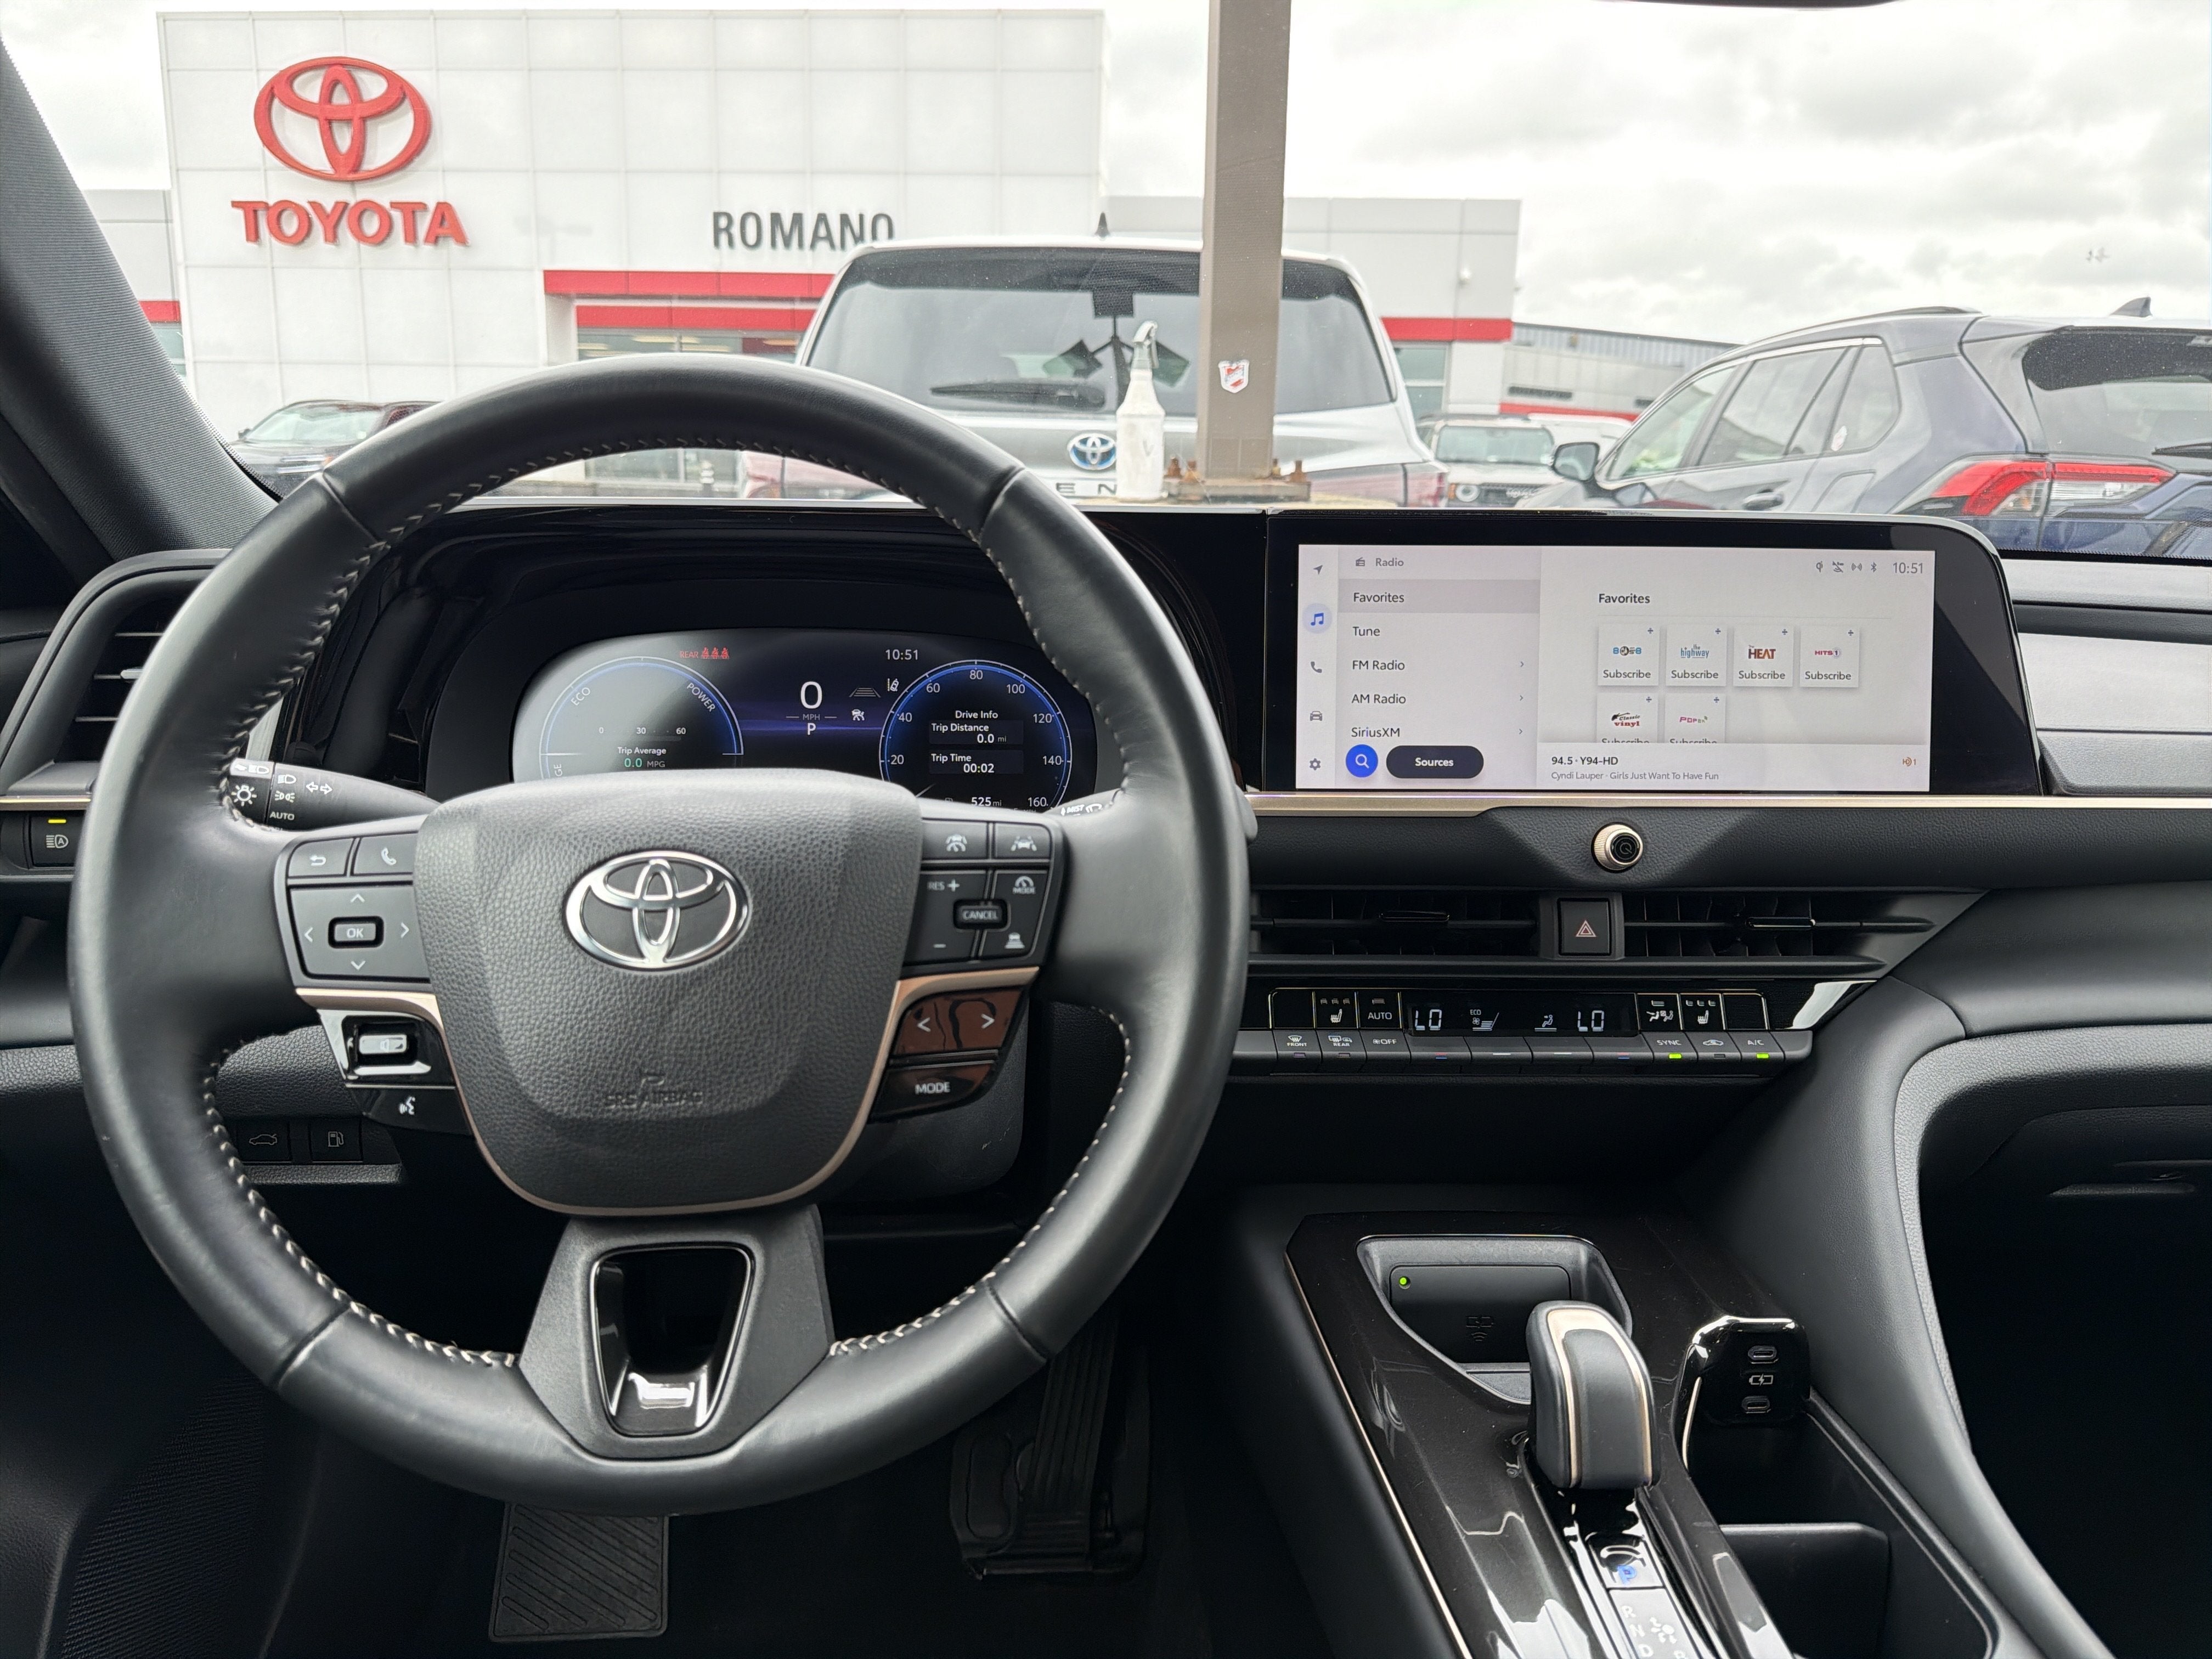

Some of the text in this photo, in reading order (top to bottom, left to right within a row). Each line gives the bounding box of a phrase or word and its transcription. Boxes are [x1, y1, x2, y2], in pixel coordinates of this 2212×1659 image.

[231, 199, 471, 246] TOYOTA
[712, 211, 894, 250] ROMANO
[1375, 557, 1404, 567] Radio
[1893, 562, 1924, 574] 10:51
[1353, 592, 1405, 603] Favorites
[1598, 593, 1651, 604] Favorites
[1352, 627, 1381, 637] Tune
[885, 649, 919, 661] 10:51
[1748, 648, 1776, 659] HEAT
[1352, 660, 1405, 670] FM Radio
[969, 669, 983, 680] 80
[1603, 670, 1651, 679] Subscribe
[1671, 670, 1719, 679] Subscribe
[1738, 670, 1786, 680] Subscribe
[1805, 671, 1852, 680] Subscribe
[926, 683, 940, 693] 60
[1006, 684, 1025, 694] 100
[571, 687, 591, 706] ECO
[686, 682, 716, 712] POWER
[800, 681, 822, 709] 0
[1351, 693, 1406, 704] AM Radio
[898, 712, 912, 722] 40
[955, 710, 998, 719] Drive Info
[1033, 713, 1052, 723] 120
[807, 723, 816, 735] P
[932, 723, 989, 733] Trip Distance
[1351, 727, 1401, 738] SiriusXM
[977, 733, 995, 743] 0.0
[617, 747, 667, 755] Trip Average
[624, 758, 642, 768] 0.0
[891, 754, 904, 765] 20
[931, 753, 972, 764] Trip Time
[1043, 755, 1062, 765] 140
[1415, 758, 1454, 767] Sources
[1551, 757, 1618, 765] 94.5 Y94-HD
[963, 763, 995, 773] 00:02
[1551, 772, 1574, 781] Cyndi
[1576, 772, 1604, 781] Lauper
[971, 797, 991, 806] 525
[1028, 797, 1047, 807] 160
[269, 811, 295, 820] AUTO
[962, 910, 998, 920] CANCEL
[346, 927, 364, 939] OK
[1368, 1012, 1392, 1020] AUTO
[915, 1082, 950, 1094] MODE
[1617, 1565, 1637, 1585] P
[1622, 1605, 1636, 1618] R
[1629, 1624, 1645, 1637] N
[1638, 1644, 1654, 1657] D
